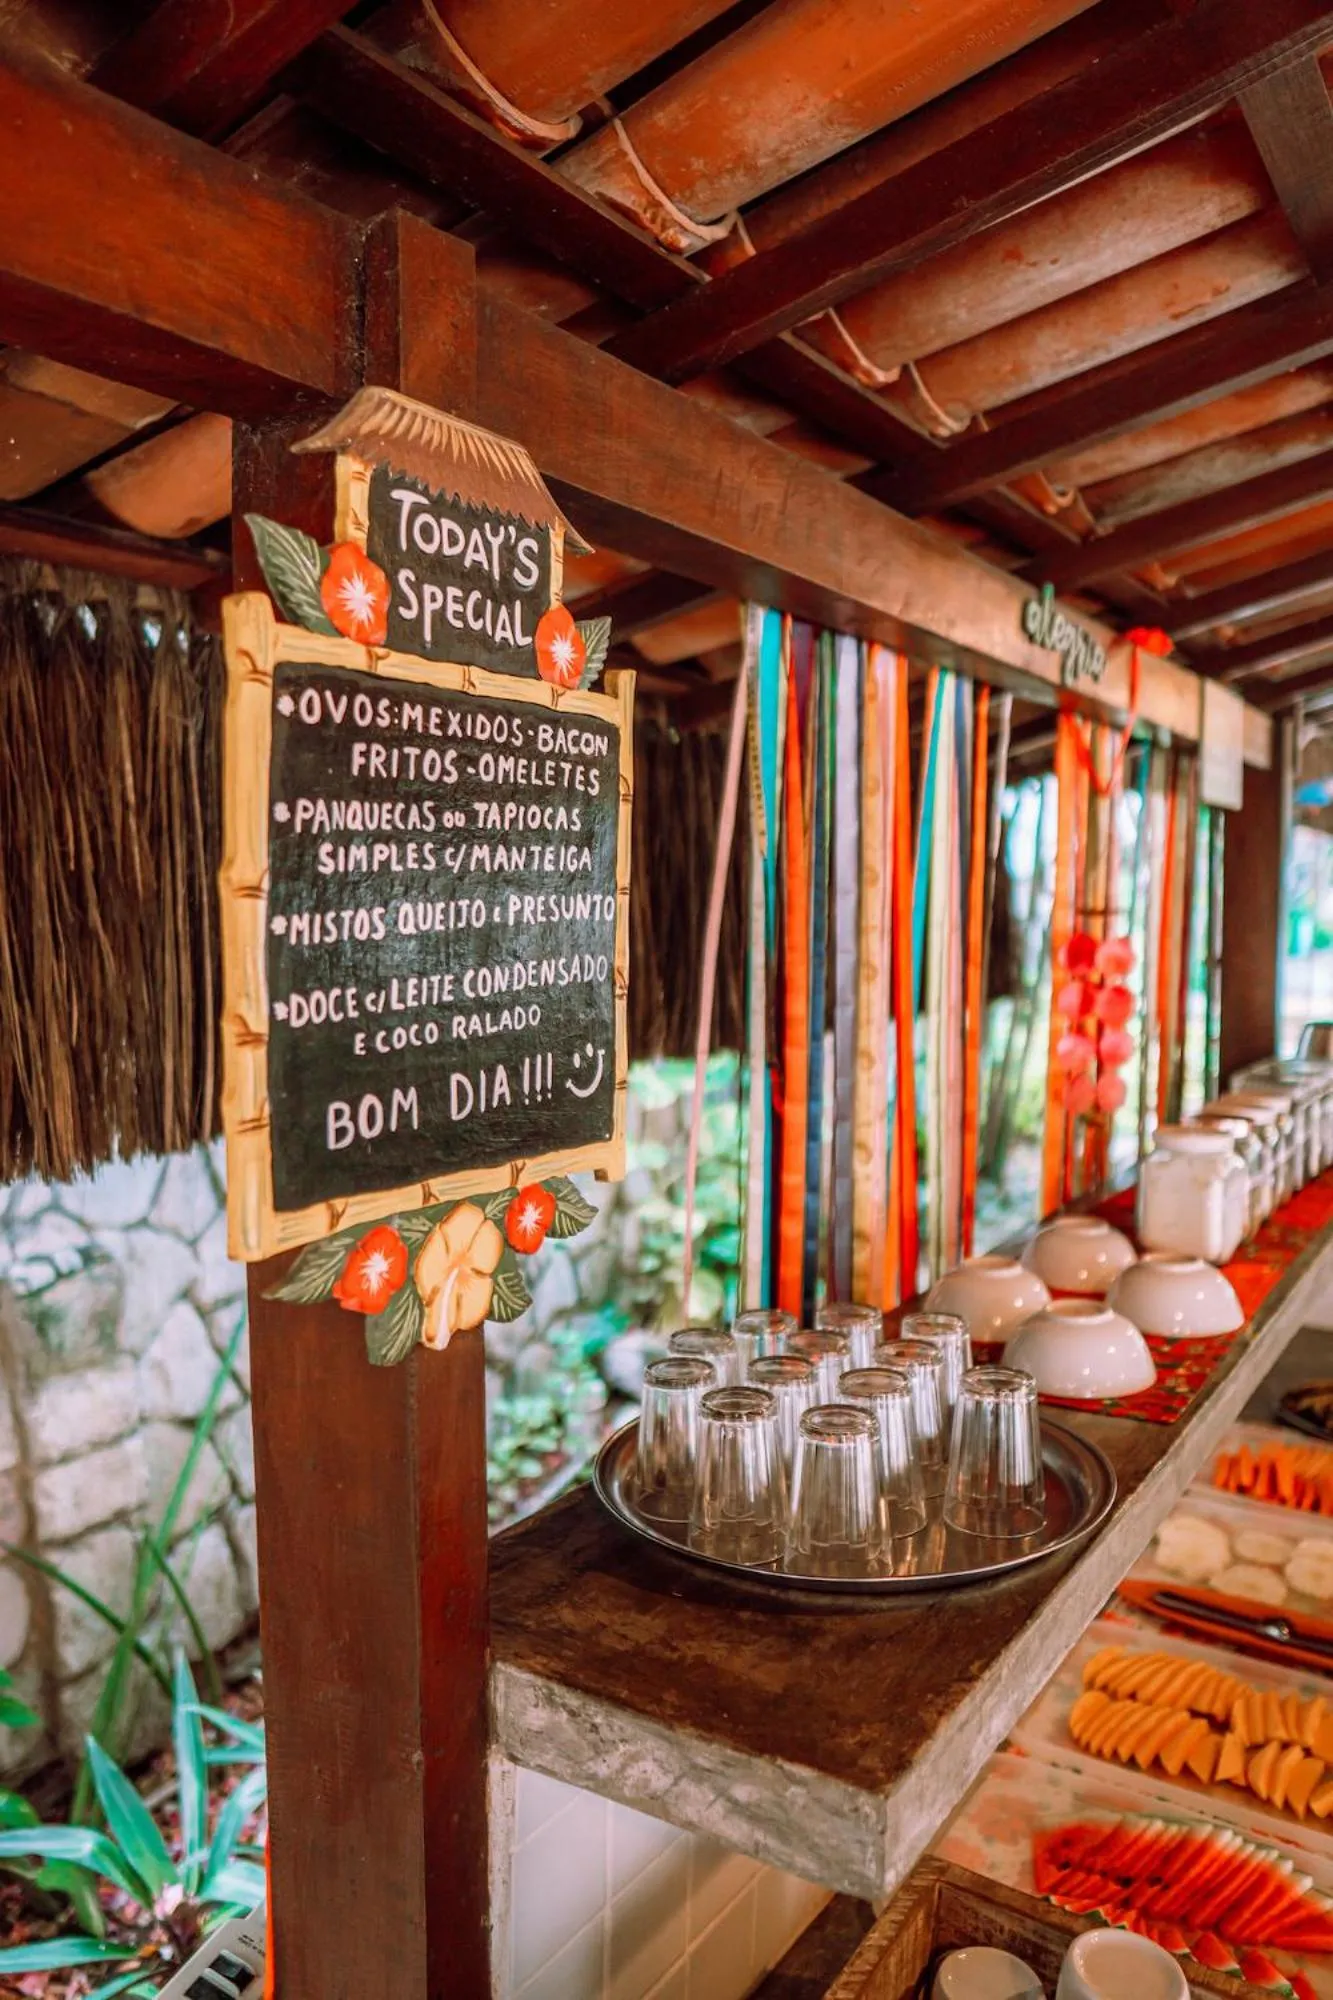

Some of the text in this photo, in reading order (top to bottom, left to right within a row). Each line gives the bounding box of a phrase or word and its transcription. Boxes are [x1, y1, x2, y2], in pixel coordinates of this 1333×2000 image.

[390, 488, 539, 588] TODAY'S
[397, 568, 534, 648] SPECIAL
[351, 741, 460, 785] FRITOS
[294, 797, 436, 835] PANQUECAS
[473, 801, 582, 832] TAPIOCAS
[317, 841, 437, 875] SIMPLES
[289, 906, 386, 946] MISTOS
[397, 899, 486, 935] QUEIJO
[507, 893, 616, 926] PRESUNTO
[288, 986, 360, 1029] DOCE
[389, 974, 455, 1011] LEITE
[462, 953, 609, 999] CONDENSADO
[353, 1004, 542, 1056] E COCO RALADO
[327, 1086, 419, 1151] BOM
